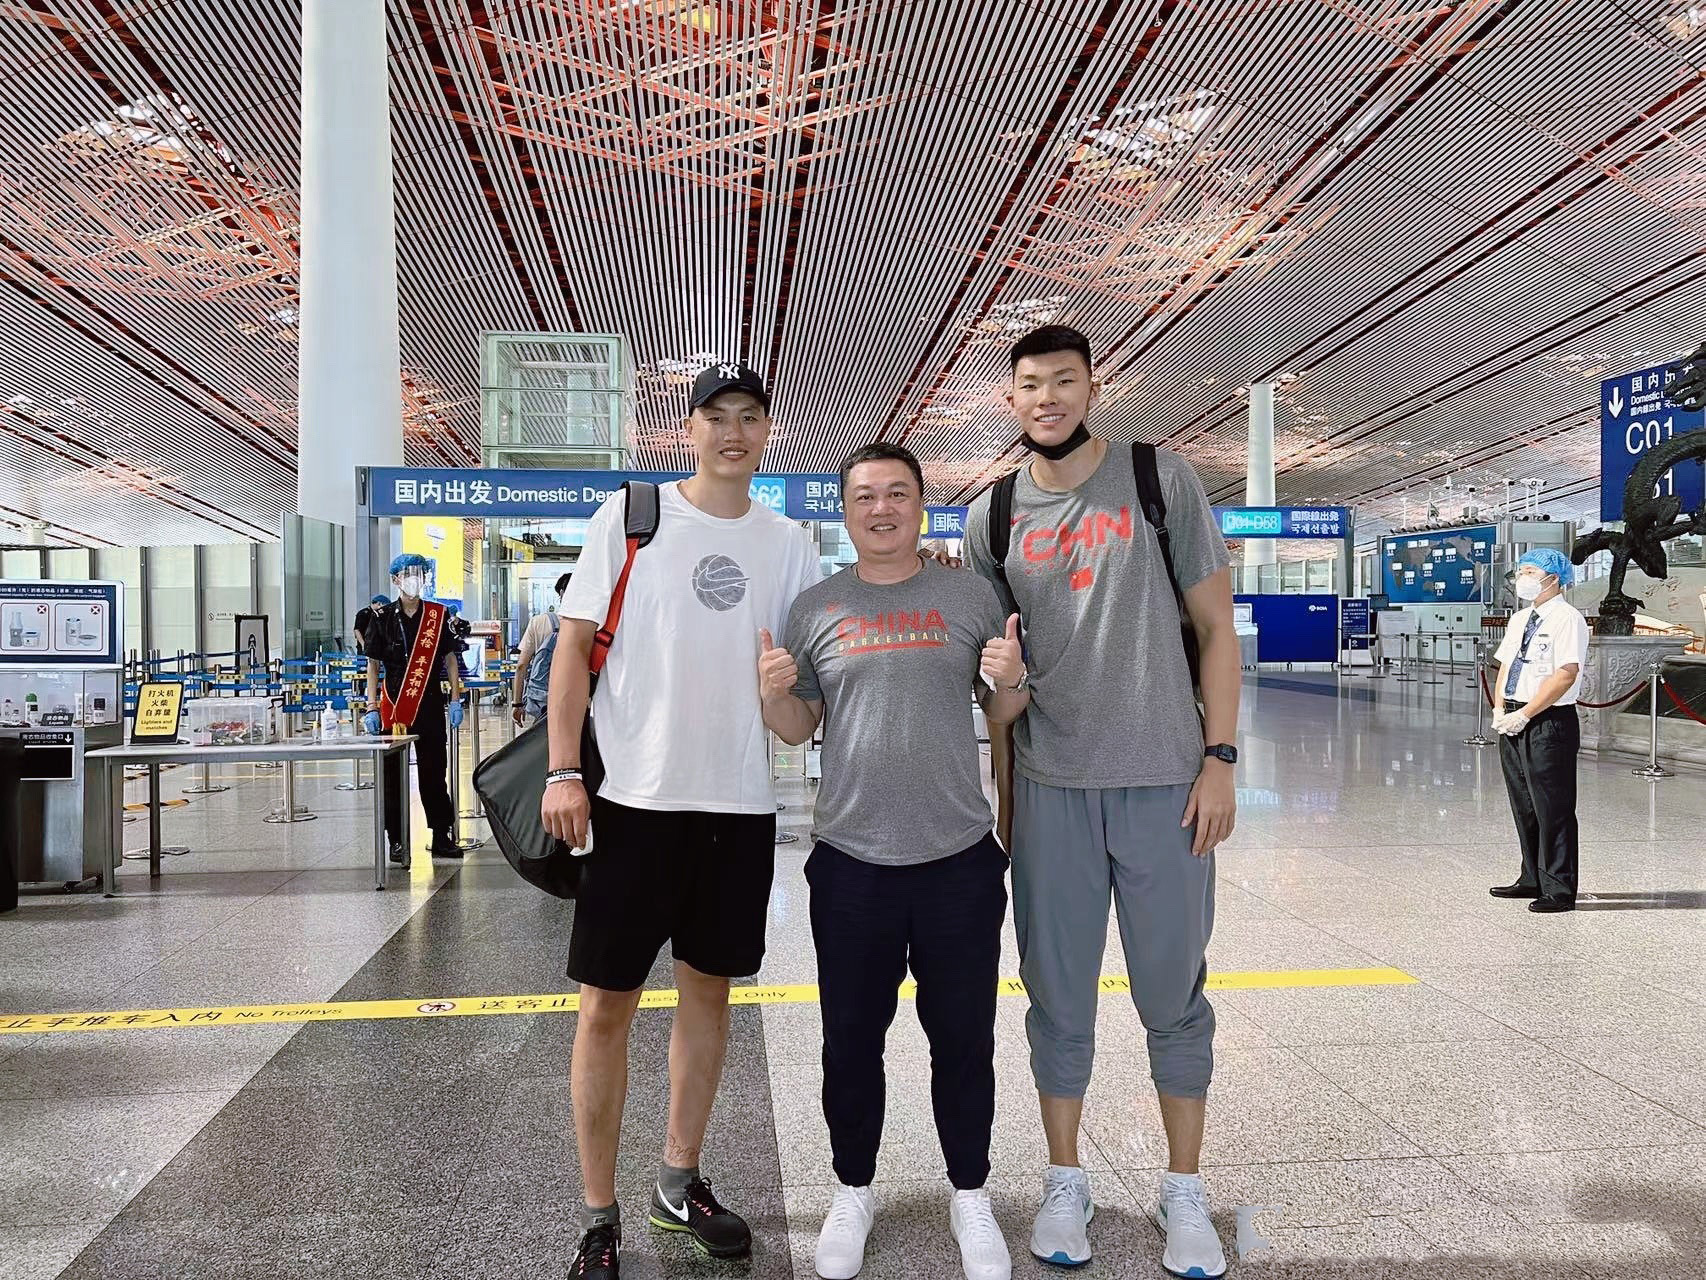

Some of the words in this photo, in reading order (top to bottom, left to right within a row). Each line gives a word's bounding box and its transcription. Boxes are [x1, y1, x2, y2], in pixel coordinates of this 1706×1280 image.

[718, 363, 740, 379] NY
[1631, 391, 1660, 405] Domestic
[1625, 416, 1674, 455] C01
[394, 479, 493, 504] 国内出发
[498, 486, 578, 503] Domestic
[933, 513, 964, 532] 国际
[1023, 505, 1132, 562] CHN
[836, 608, 948, 642] CHINA
[838, 631, 950, 652] BASKETBALL
[744, 989, 787, 999] Only
[0, 1011, 223, 1028] 止手推车入内
[272, 1008, 343, 1017] Trolleys
